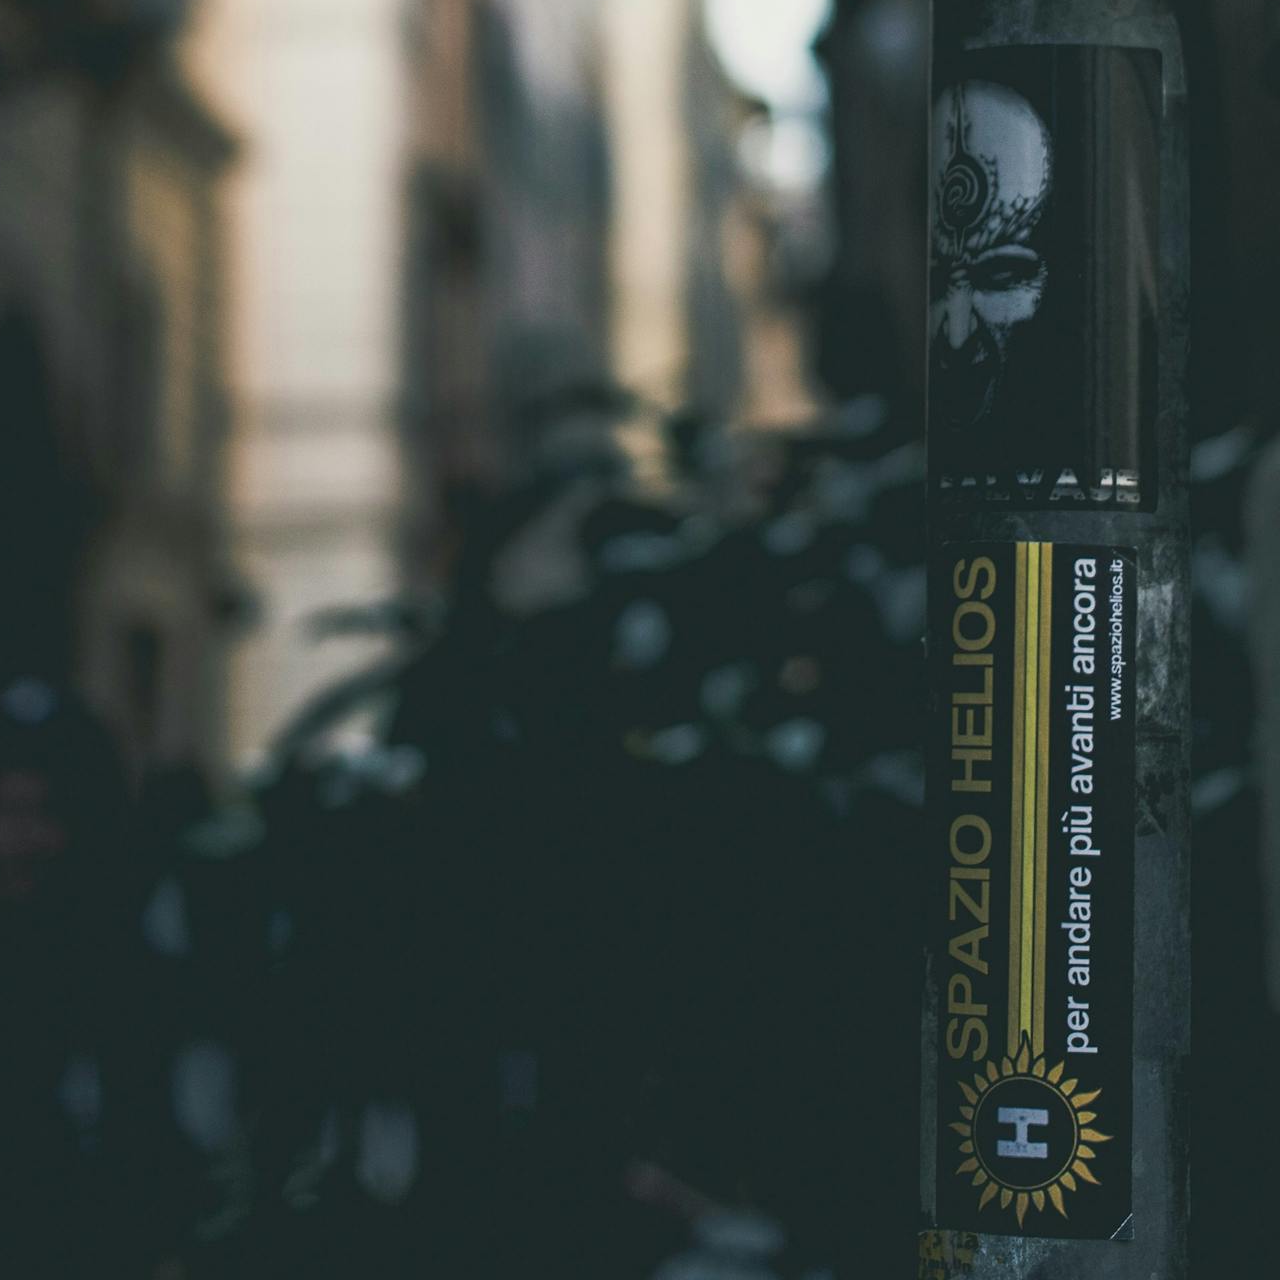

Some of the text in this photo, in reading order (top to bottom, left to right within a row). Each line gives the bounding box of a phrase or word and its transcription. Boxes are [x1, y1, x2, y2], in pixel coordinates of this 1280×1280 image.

[1108, 558, 1127, 721] www.spaziohelios.it
[946, 556, 997, 1063] SPAZIO HELIOS
[1060, 558, 1101, 1054] per andare più avanti ancora
[998, 1107, 1049, 1159] H
